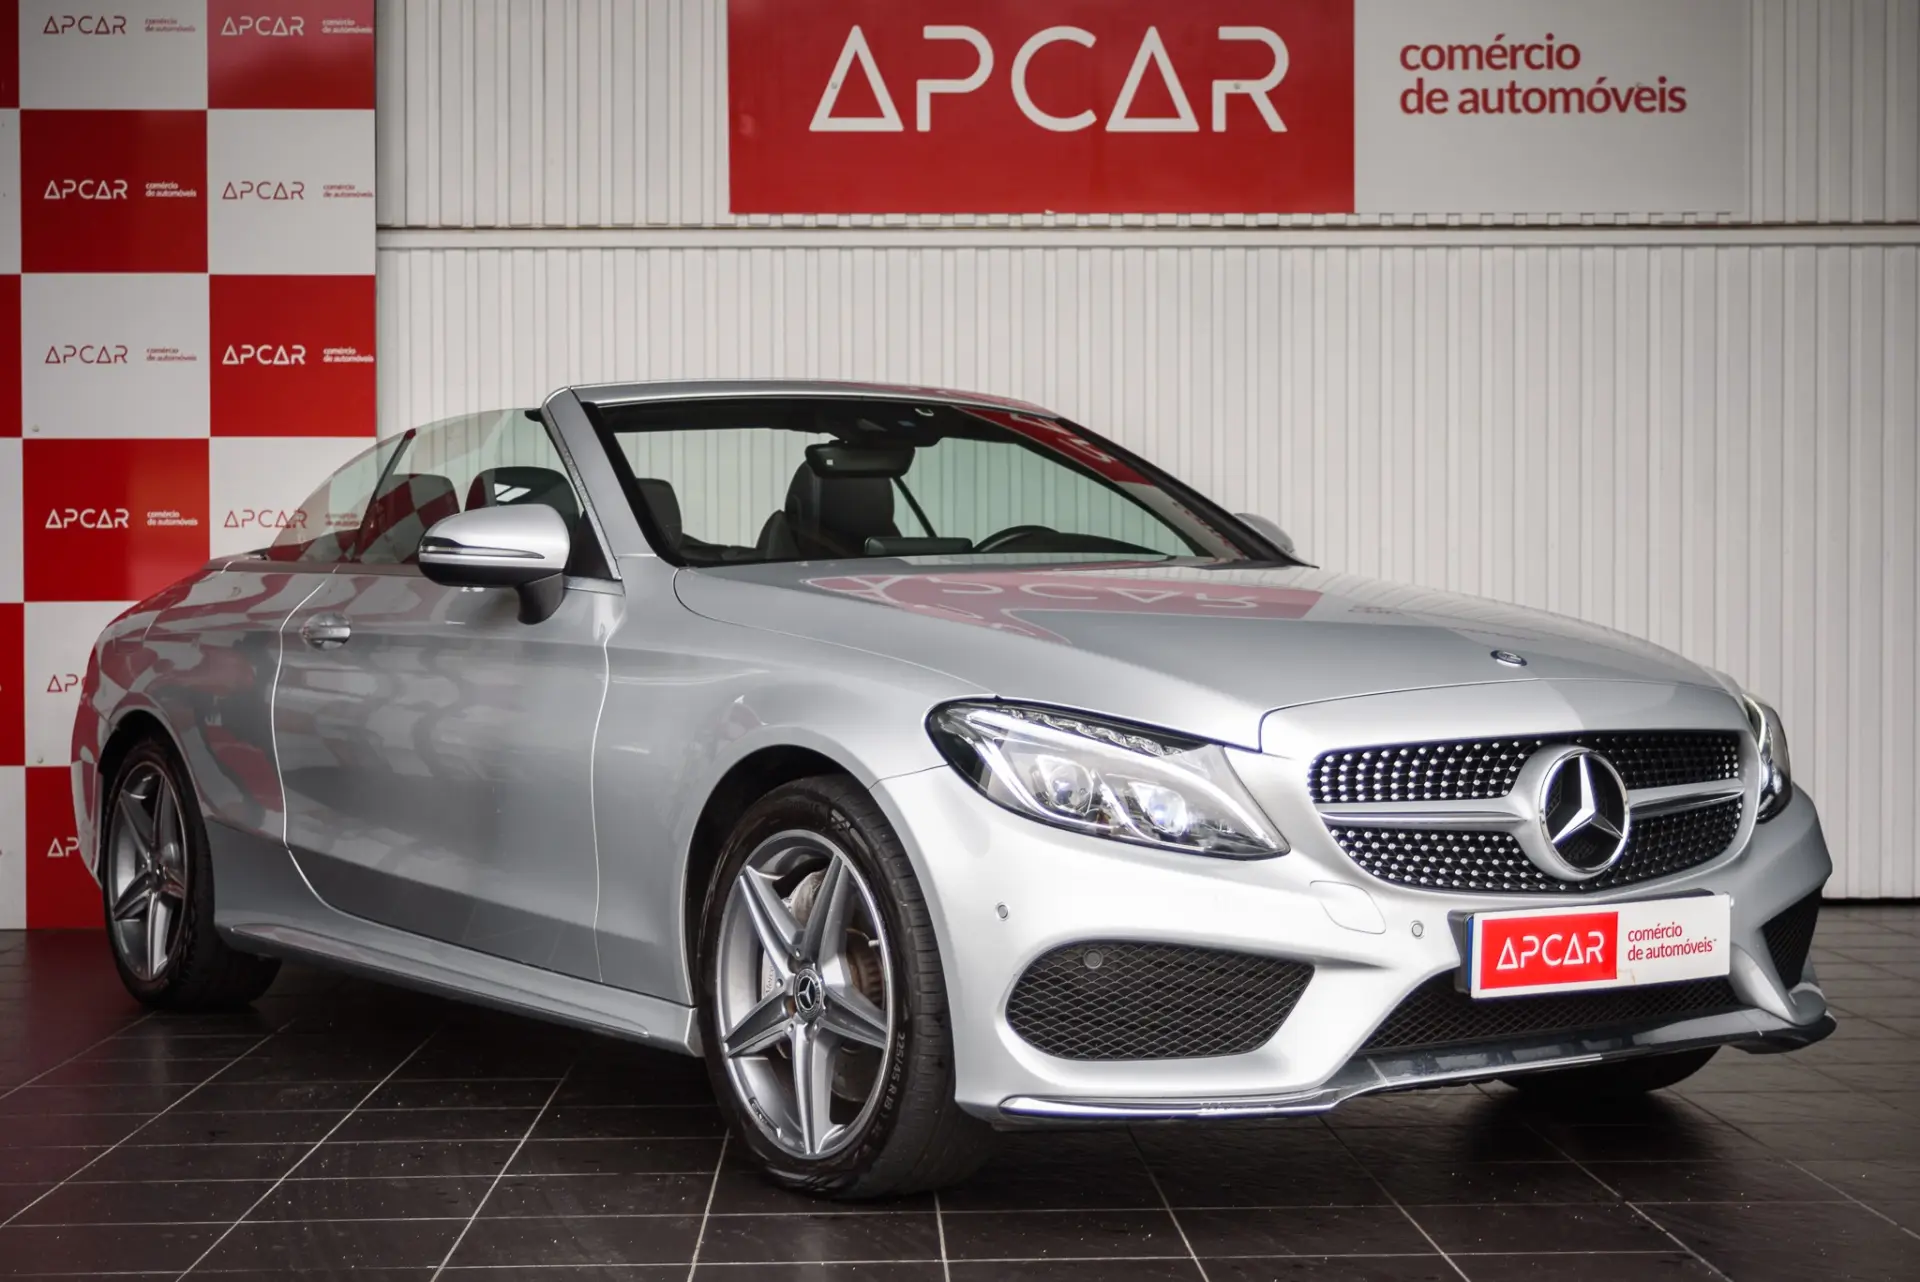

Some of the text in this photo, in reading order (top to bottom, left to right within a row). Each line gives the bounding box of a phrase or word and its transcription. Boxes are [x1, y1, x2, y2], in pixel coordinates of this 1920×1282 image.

[43, 15, 127, 35] APCAR
[221, 16, 305, 36] APCAR
[1400, 32, 1581, 71] comércio
[809, 25, 1290, 133] APCAR
[1400, 76, 1688, 114] de automóveis
[44, 180, 129, 200] APCAR
[146, 188, 154, 197] de
[222, 181, 305, 200] APCAR
[45, 345, 129, 364] APCAR
[222, 345, 306, 365] APCAR
[45, 508, 130, 529] APCAR
[147, 517, 155, 526] de
[223, 509, 308, 529] APCAR
[1628, 922, 1683, 943] comércio
[1496, 931, 1605, 970] APCAR
[1628, 937, 1713, 962] de automóveis
